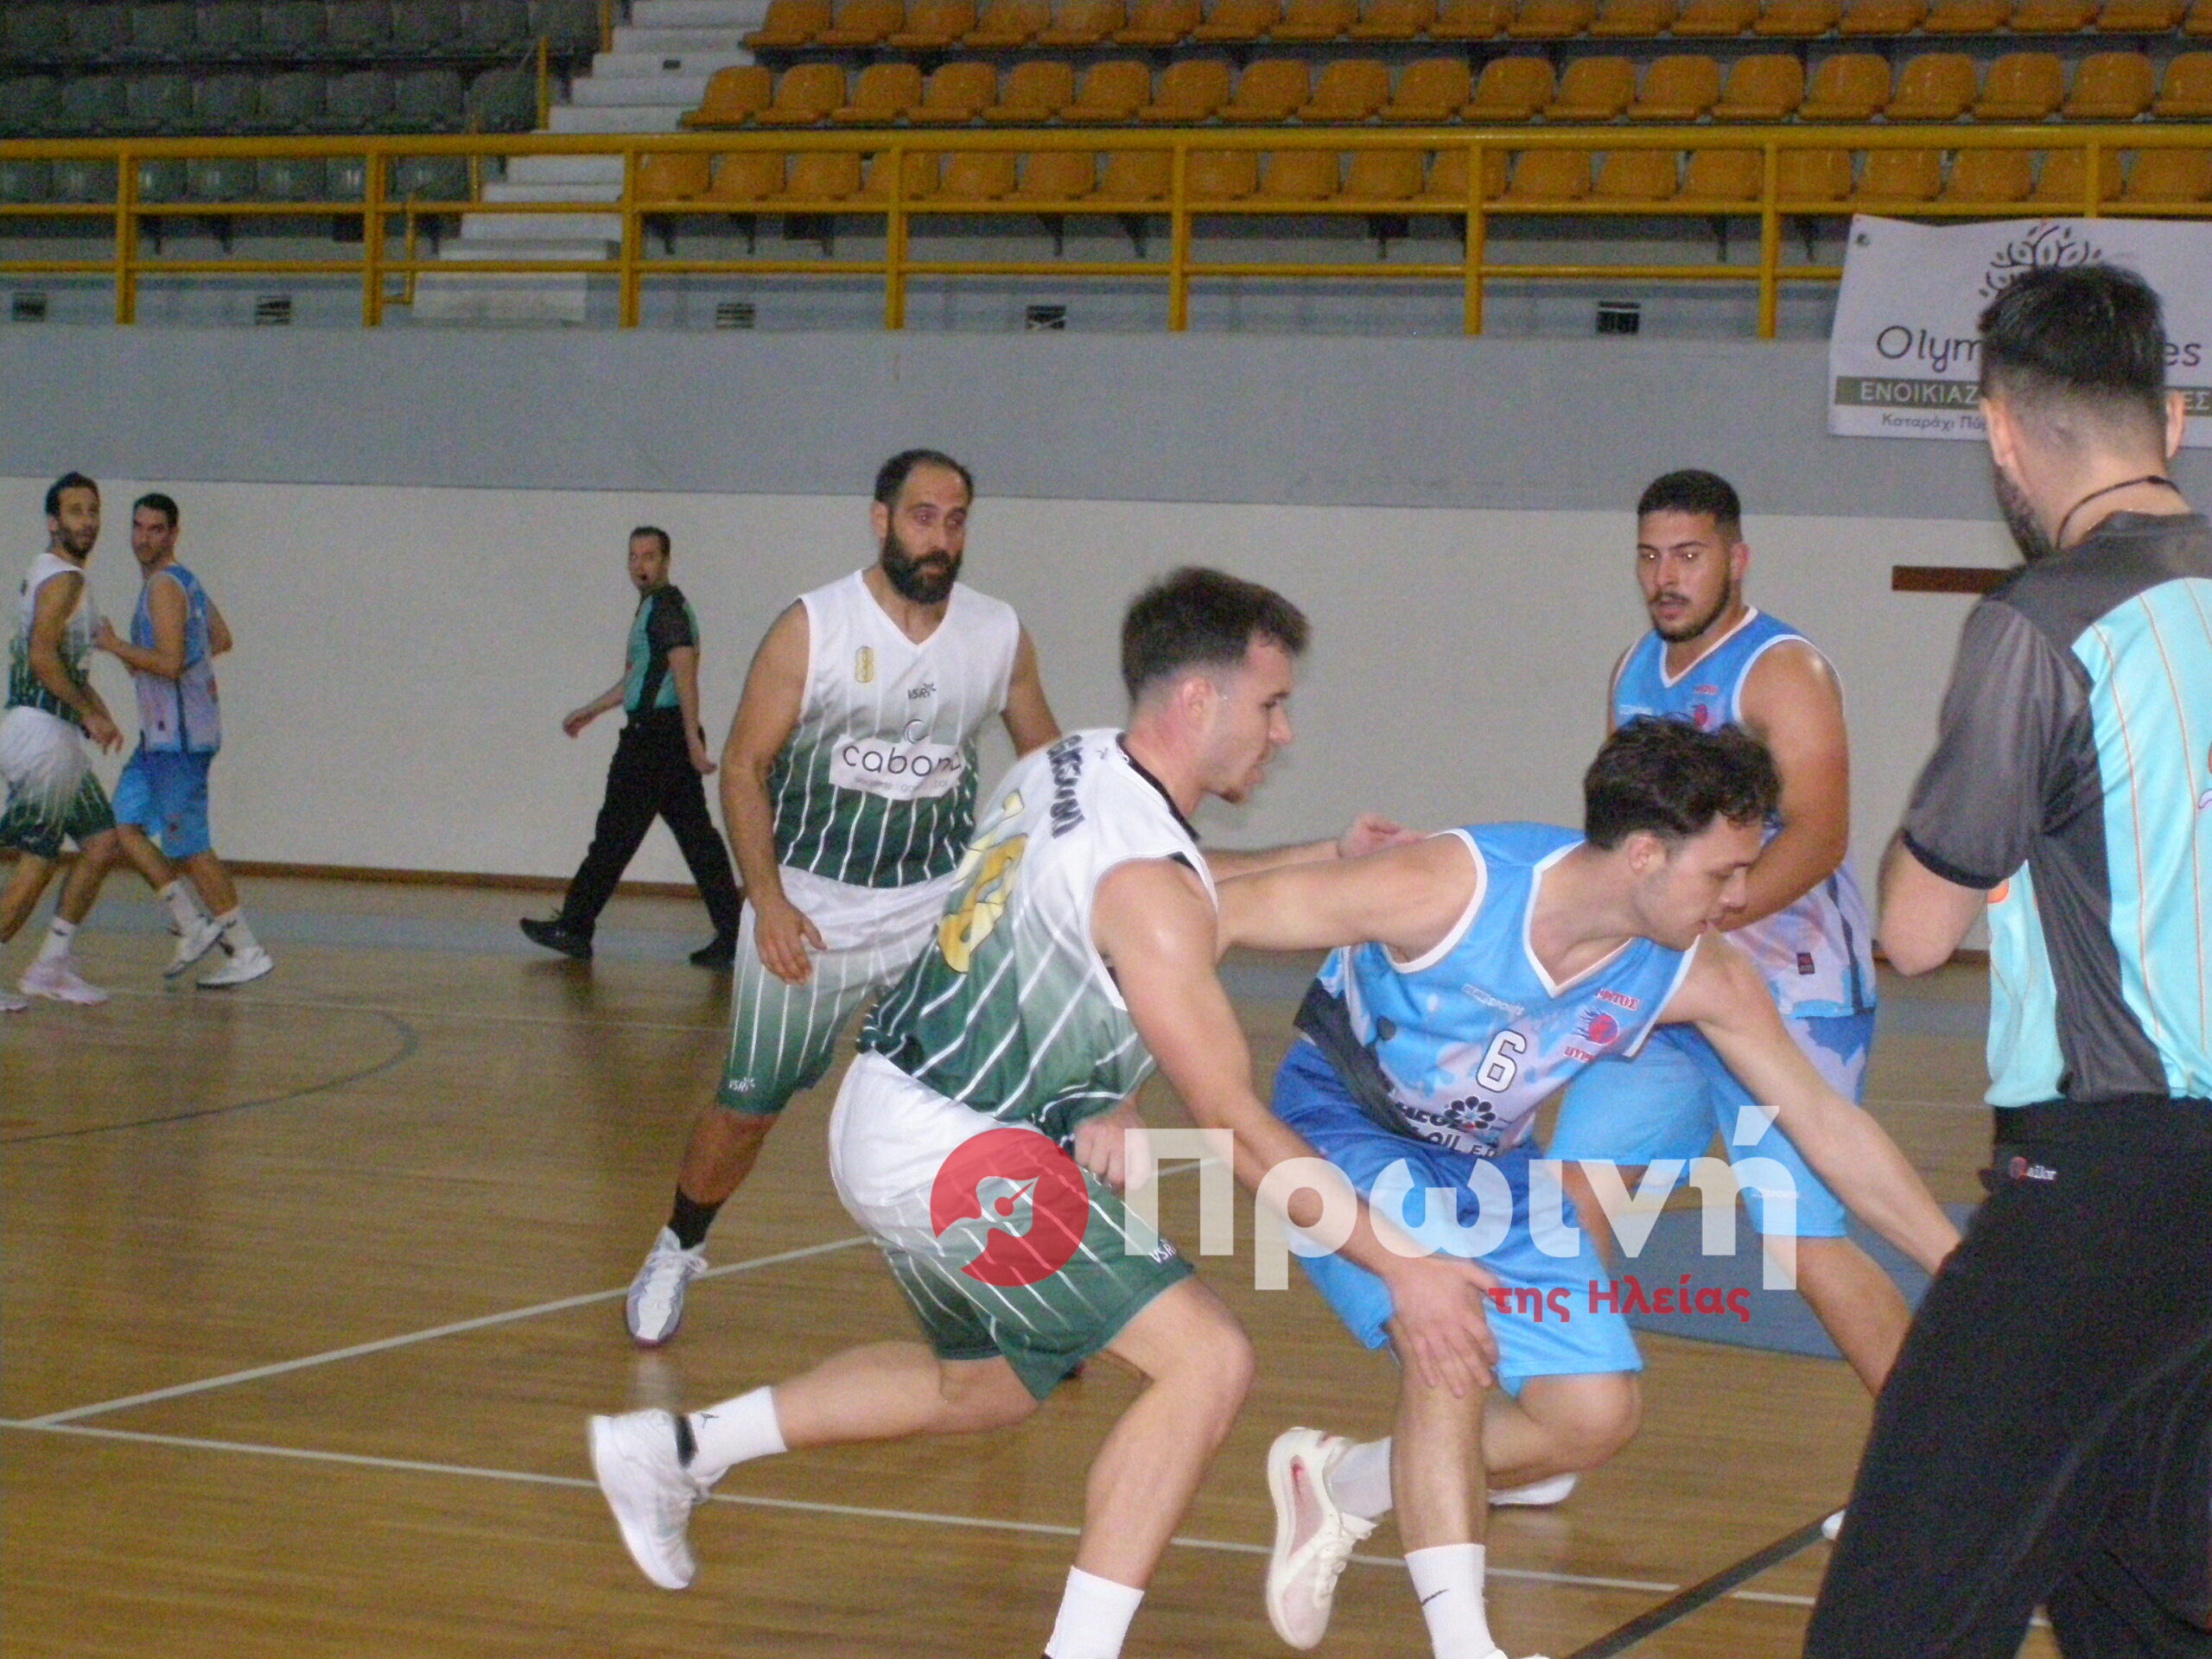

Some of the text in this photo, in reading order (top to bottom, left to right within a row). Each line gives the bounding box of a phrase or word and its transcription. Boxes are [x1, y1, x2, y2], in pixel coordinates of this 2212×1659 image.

[1876, 325, 2202, 373] Olym es
[1860, 381, 2210, 412] ΕΝΟΙΚΙΑΖ ΕΣ
[1475, 1028, 1528, 1094] 6
